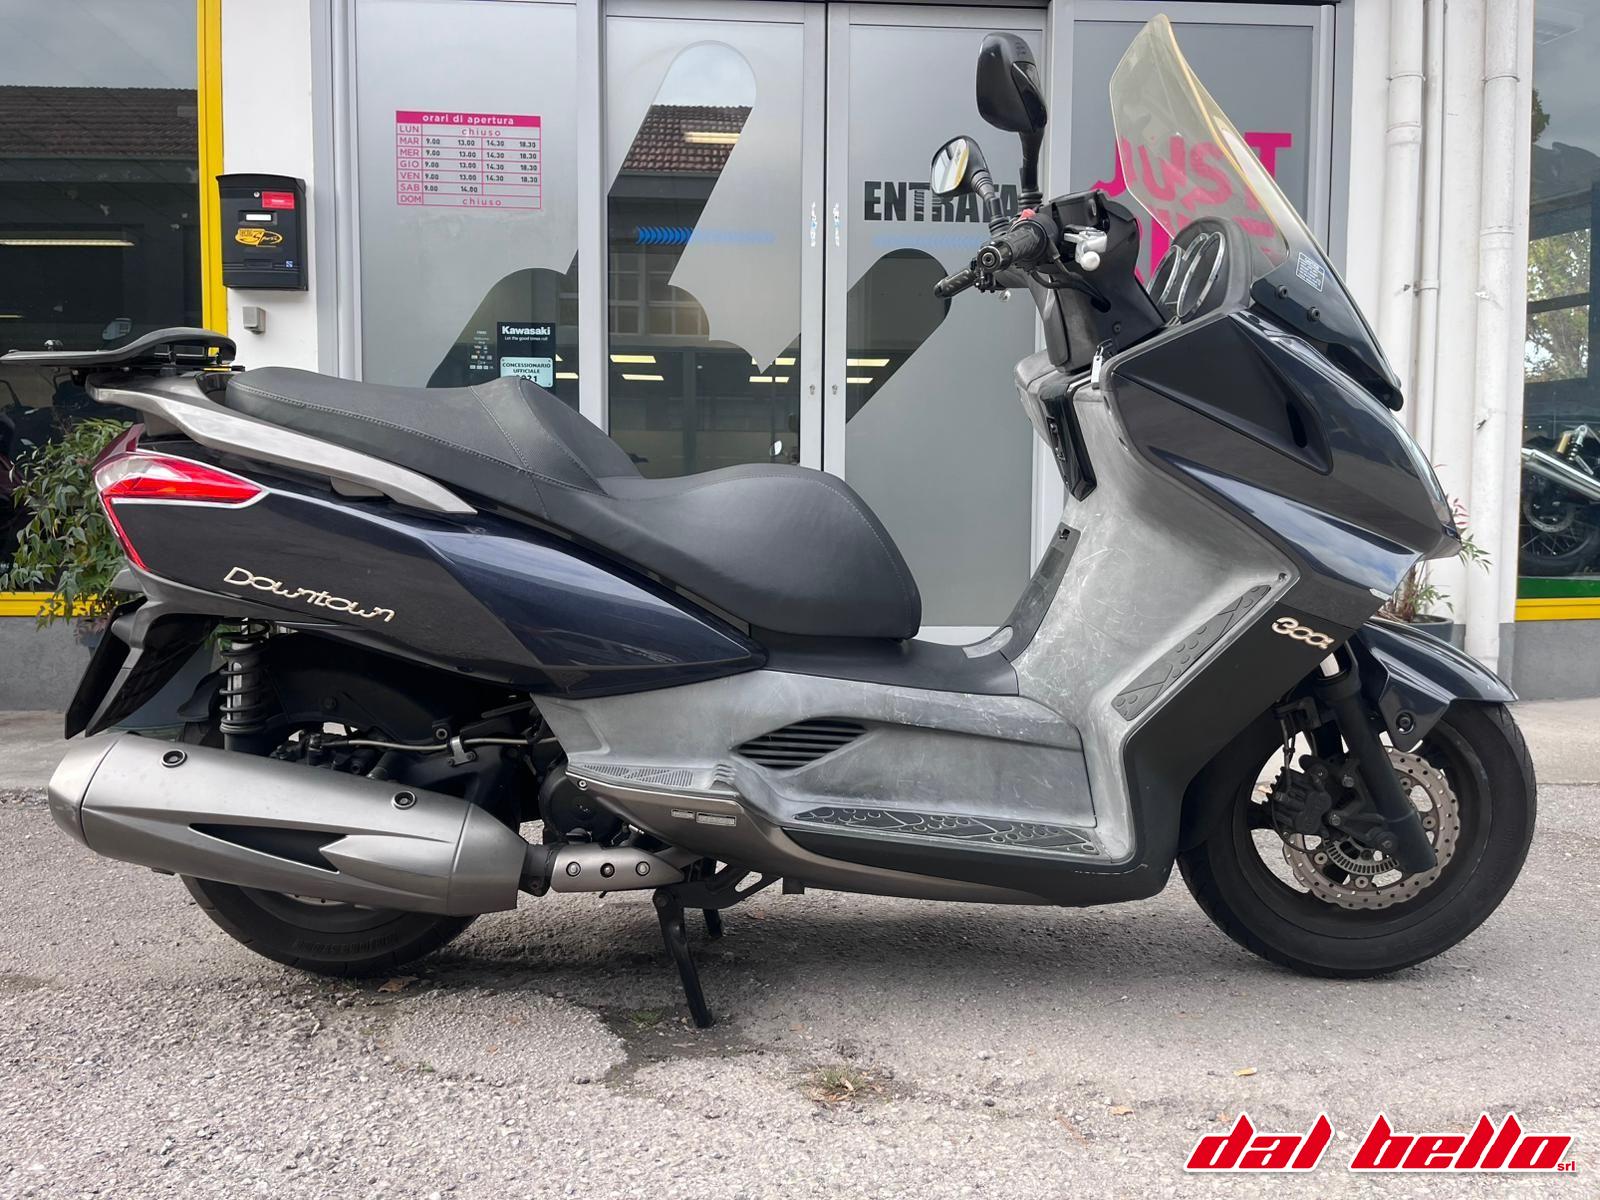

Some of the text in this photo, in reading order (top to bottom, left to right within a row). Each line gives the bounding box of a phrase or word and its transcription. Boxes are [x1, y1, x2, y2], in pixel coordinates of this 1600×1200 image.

[422, 114, 514, 126] orari di apertura
[399, 125, 501, 136] LUN chiuso
[400, 137, 419, 145] MAR
[400, 148, 419, 156] MER
[400, 160, 419, 168] GIO
[400, 183, 420, 191] SAB
[400, 195, 502, 206] DOM chiuso
[501, 325, 551, 335] Kawasaki
[224, 567, 396, 622] Downtown
